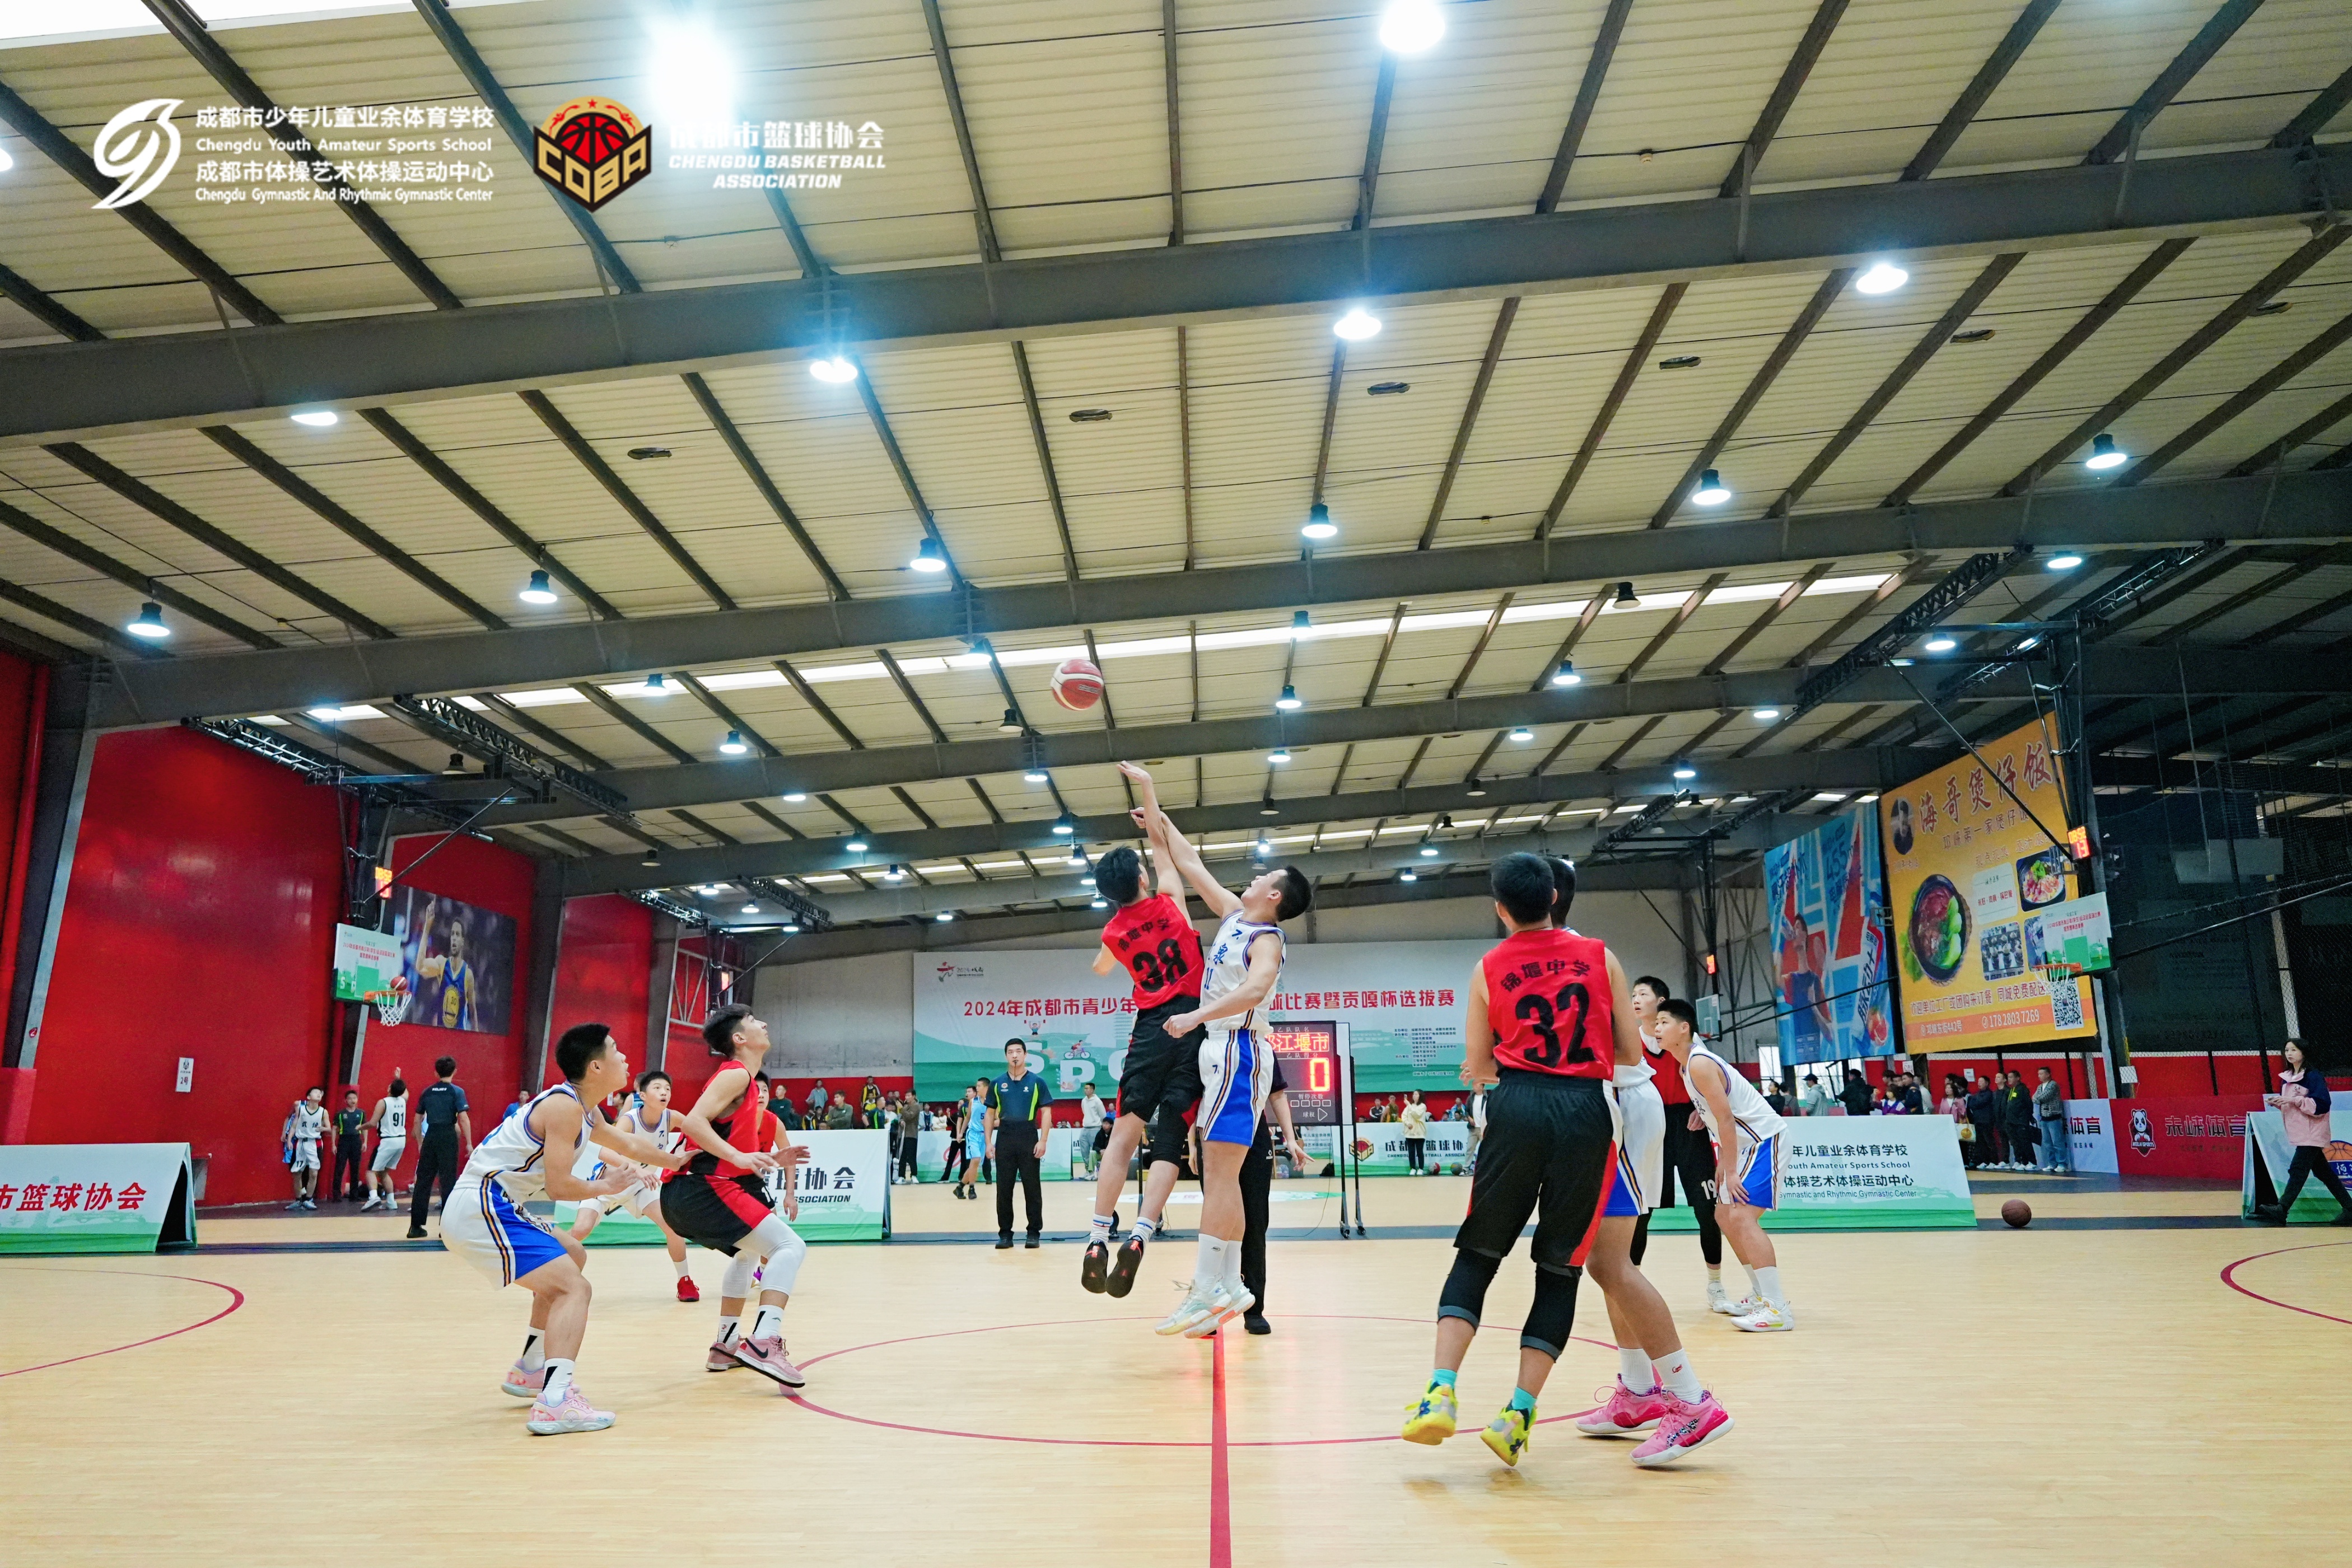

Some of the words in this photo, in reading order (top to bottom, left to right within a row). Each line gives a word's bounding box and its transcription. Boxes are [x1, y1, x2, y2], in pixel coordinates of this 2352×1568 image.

[1920, 740, 2054, 836] 海哥煲仔饭
[2076, 839, 2090, 858] 13
[1132, 938, 1188, 992] 38
[964, 997, 1136, 1017] 2024年成都市青少年
[1515, 982, 1597, 1068] 32
[1989, 1014, 2001, 1028] 178
[2003, 1012, 2020, 1025] 2803
[2022, 1009, 2040, 1023] 7269
[1309, 1057, 1331, 1092] 0
[393, 1112, 404, 1127] 91
[1385, 1140, 1465, 1151] 成都篮球协
[1793, 1144, 1908, 1157] 年儿童业余体育学校
[1850, 1161, 1879, 1171] Sports
[1701, 1179, 1718, 1200] 19
[1784, 1175, 1914, 1188] 体操艺术体操运动中心
[795, 1194, 851, 1203] SSOCIATION
[1827, 1191, 1858, 1199] Rhythmic
[1859, 1190, 1893, 1198] Gymnastic
